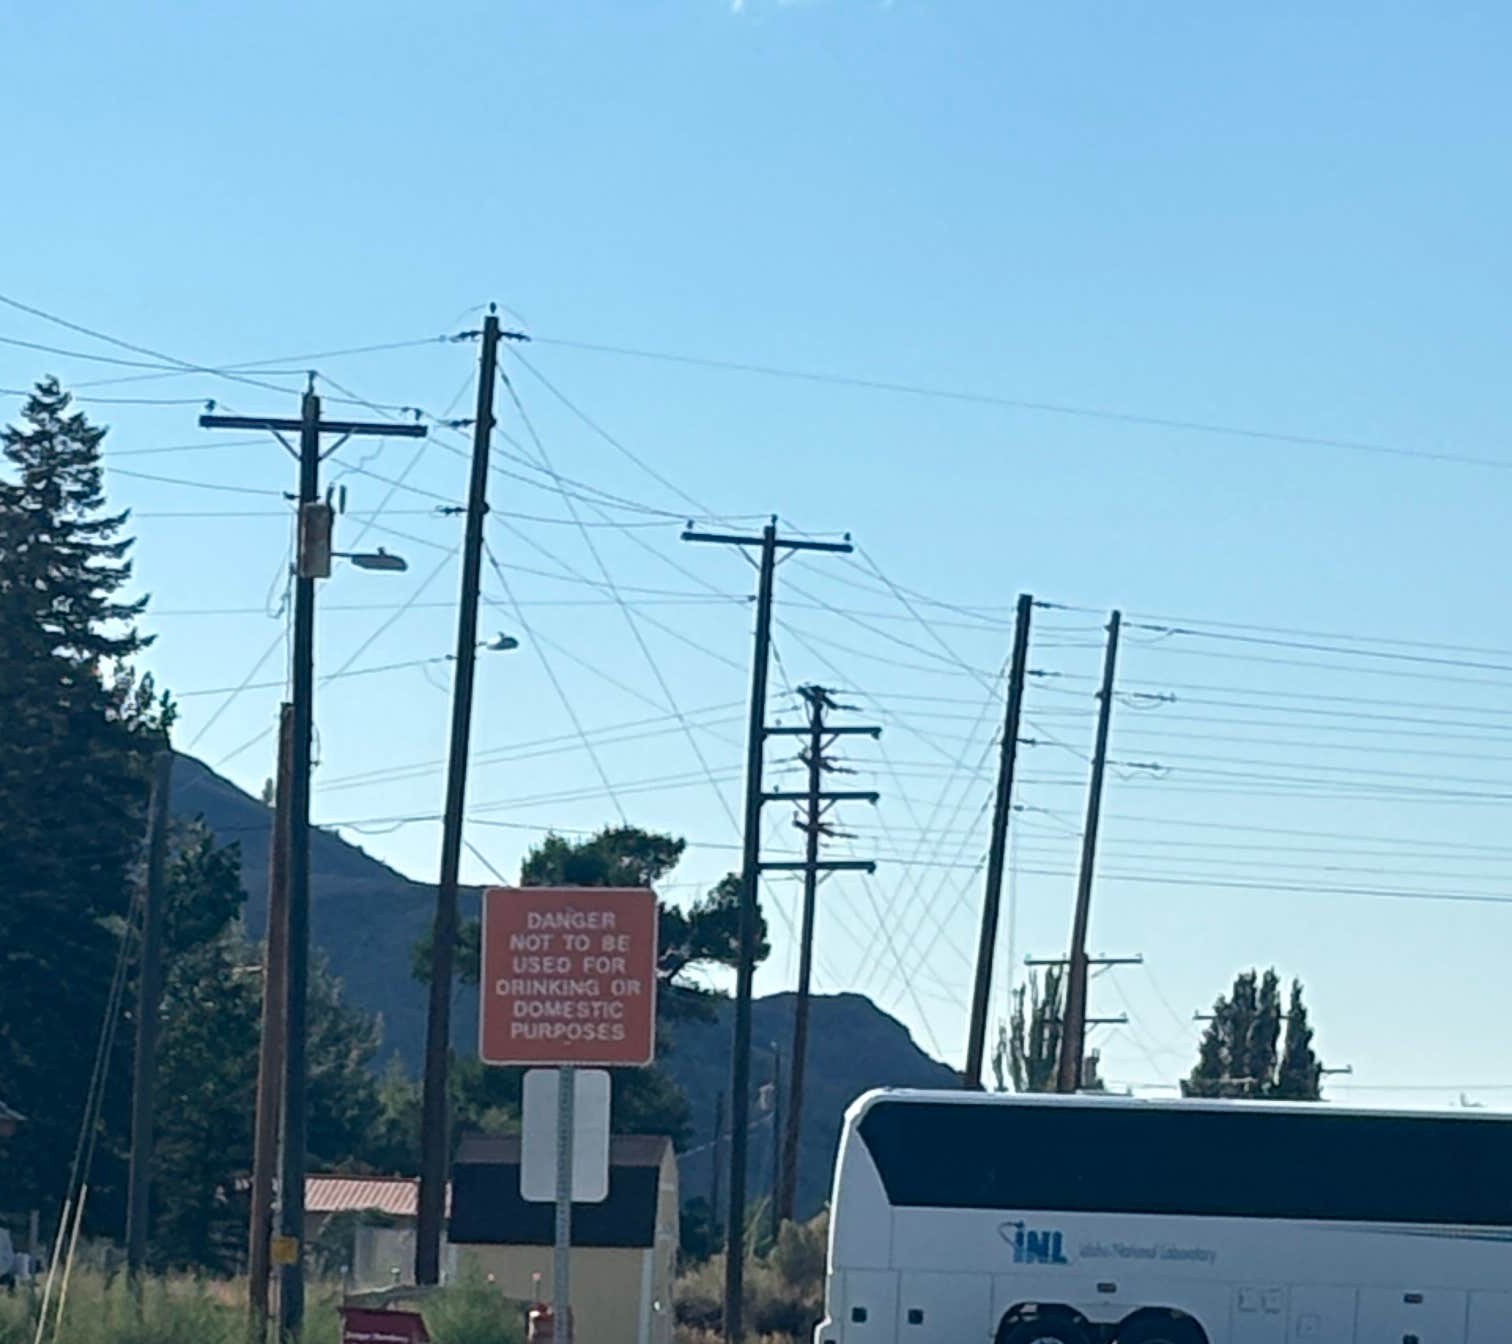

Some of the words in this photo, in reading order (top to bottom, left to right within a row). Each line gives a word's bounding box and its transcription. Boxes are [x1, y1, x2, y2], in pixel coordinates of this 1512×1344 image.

[527, 911, 616, 930] DANGER
[509, 934, 553, 951] NOT
[563, 934, 591, 951] TO
[601, 934, 631, 952] BE
[512, 956, 572, 974] USED
[583, 957, 627, 974] FOR
[495, 978, 600, 996] DRINKING
[610, 979, 641, 996] OR
[513, 1001, 624, 1019] DOMESTIC
[510, 1022, 625, 1041] PURPOSES
